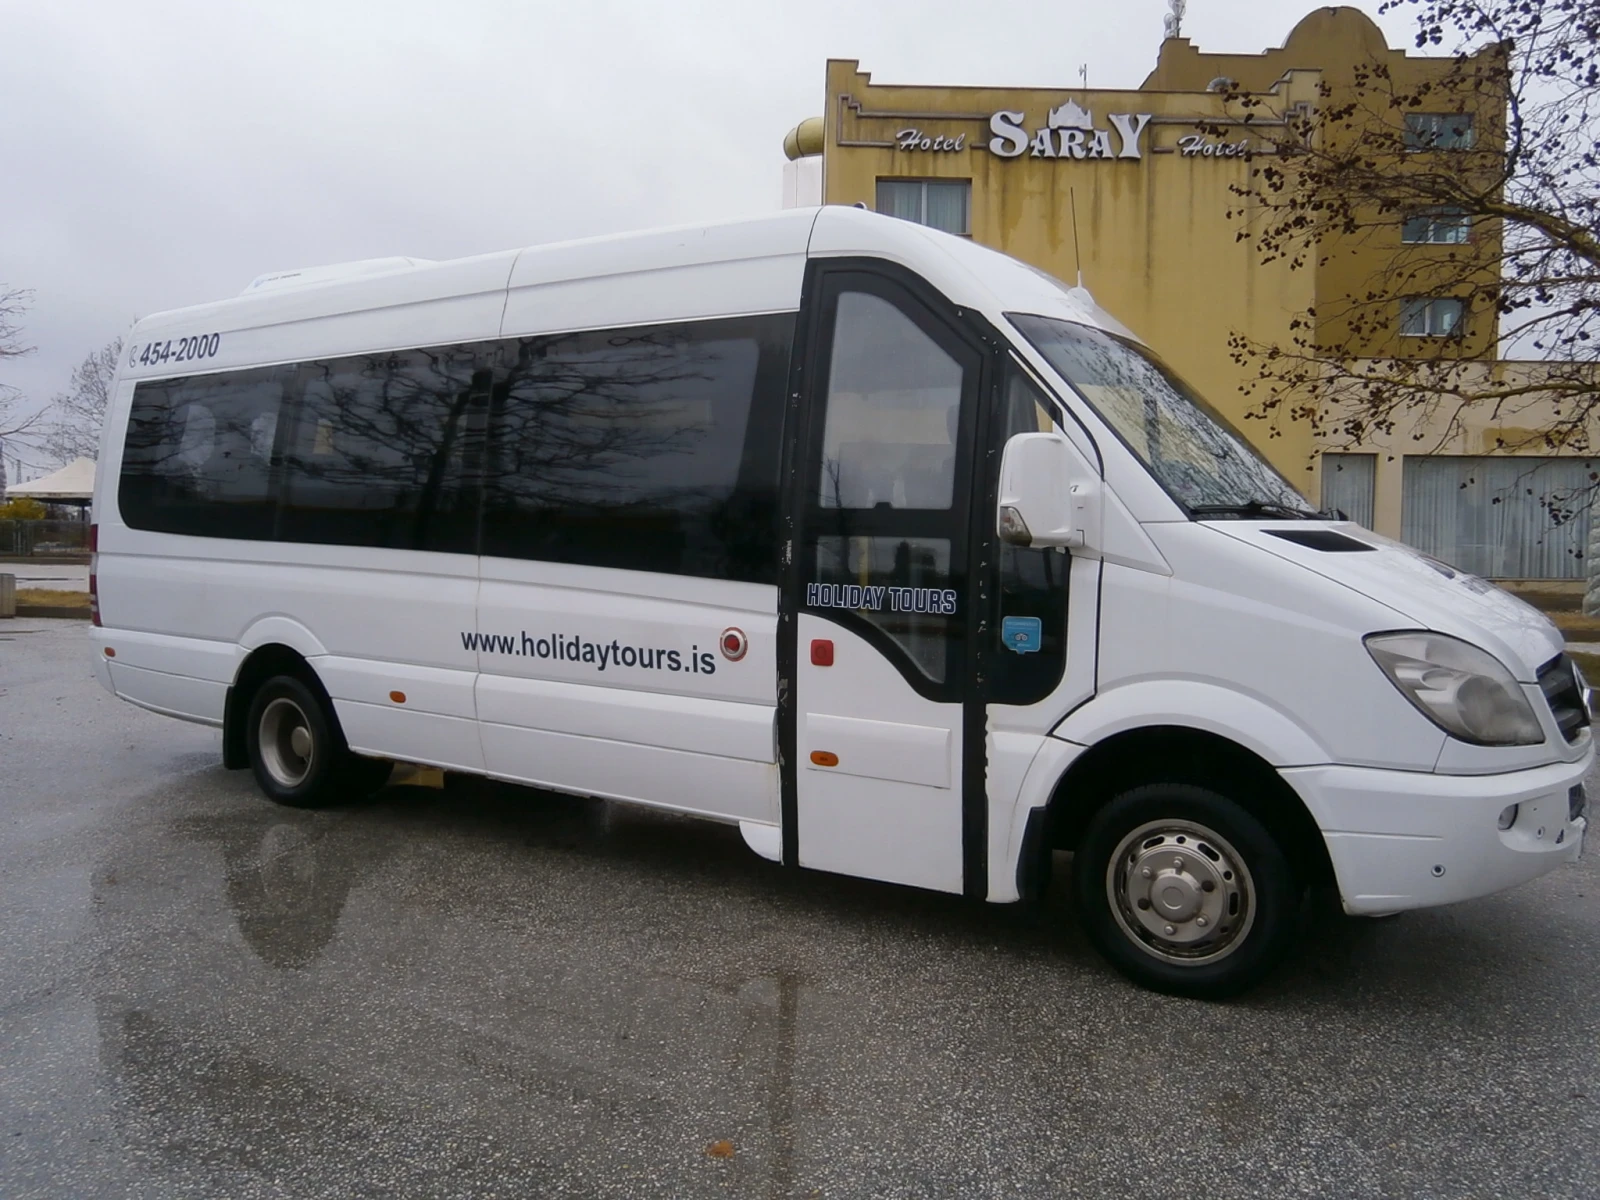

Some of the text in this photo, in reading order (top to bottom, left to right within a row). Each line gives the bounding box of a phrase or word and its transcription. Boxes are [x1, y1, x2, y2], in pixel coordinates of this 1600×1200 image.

[895, 110, 1247, 160] Hotel SARAY Hotel
[140, 332, 220, 366] 454-2000
[806, 582, 957, 615] HOLIDAY TOURS
[460, 630, 717, 675] www.holidaytours.is
